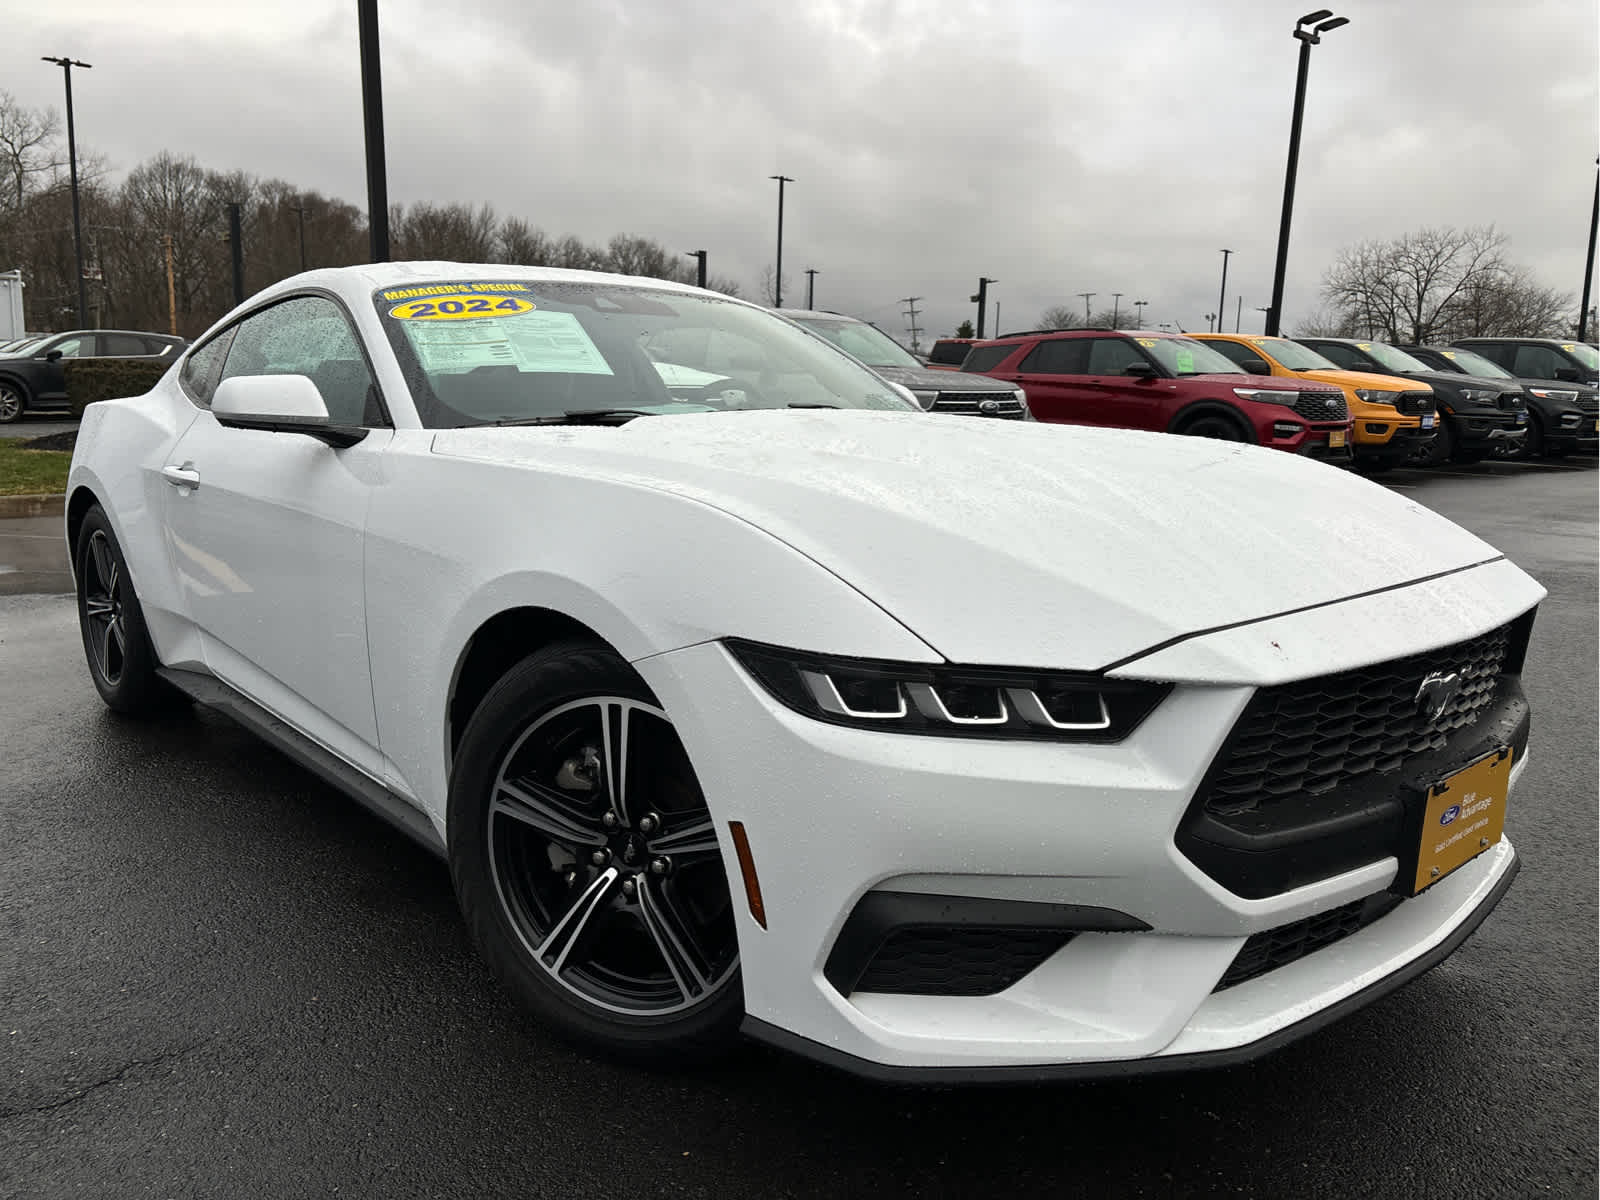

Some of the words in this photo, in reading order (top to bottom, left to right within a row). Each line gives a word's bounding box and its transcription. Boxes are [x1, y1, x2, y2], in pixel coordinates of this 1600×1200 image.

[384, 284, 472, 300] MANAGER'S
[471, 283, 530, 293] SPECIAL
[409, 299, 522, 317] 2024
